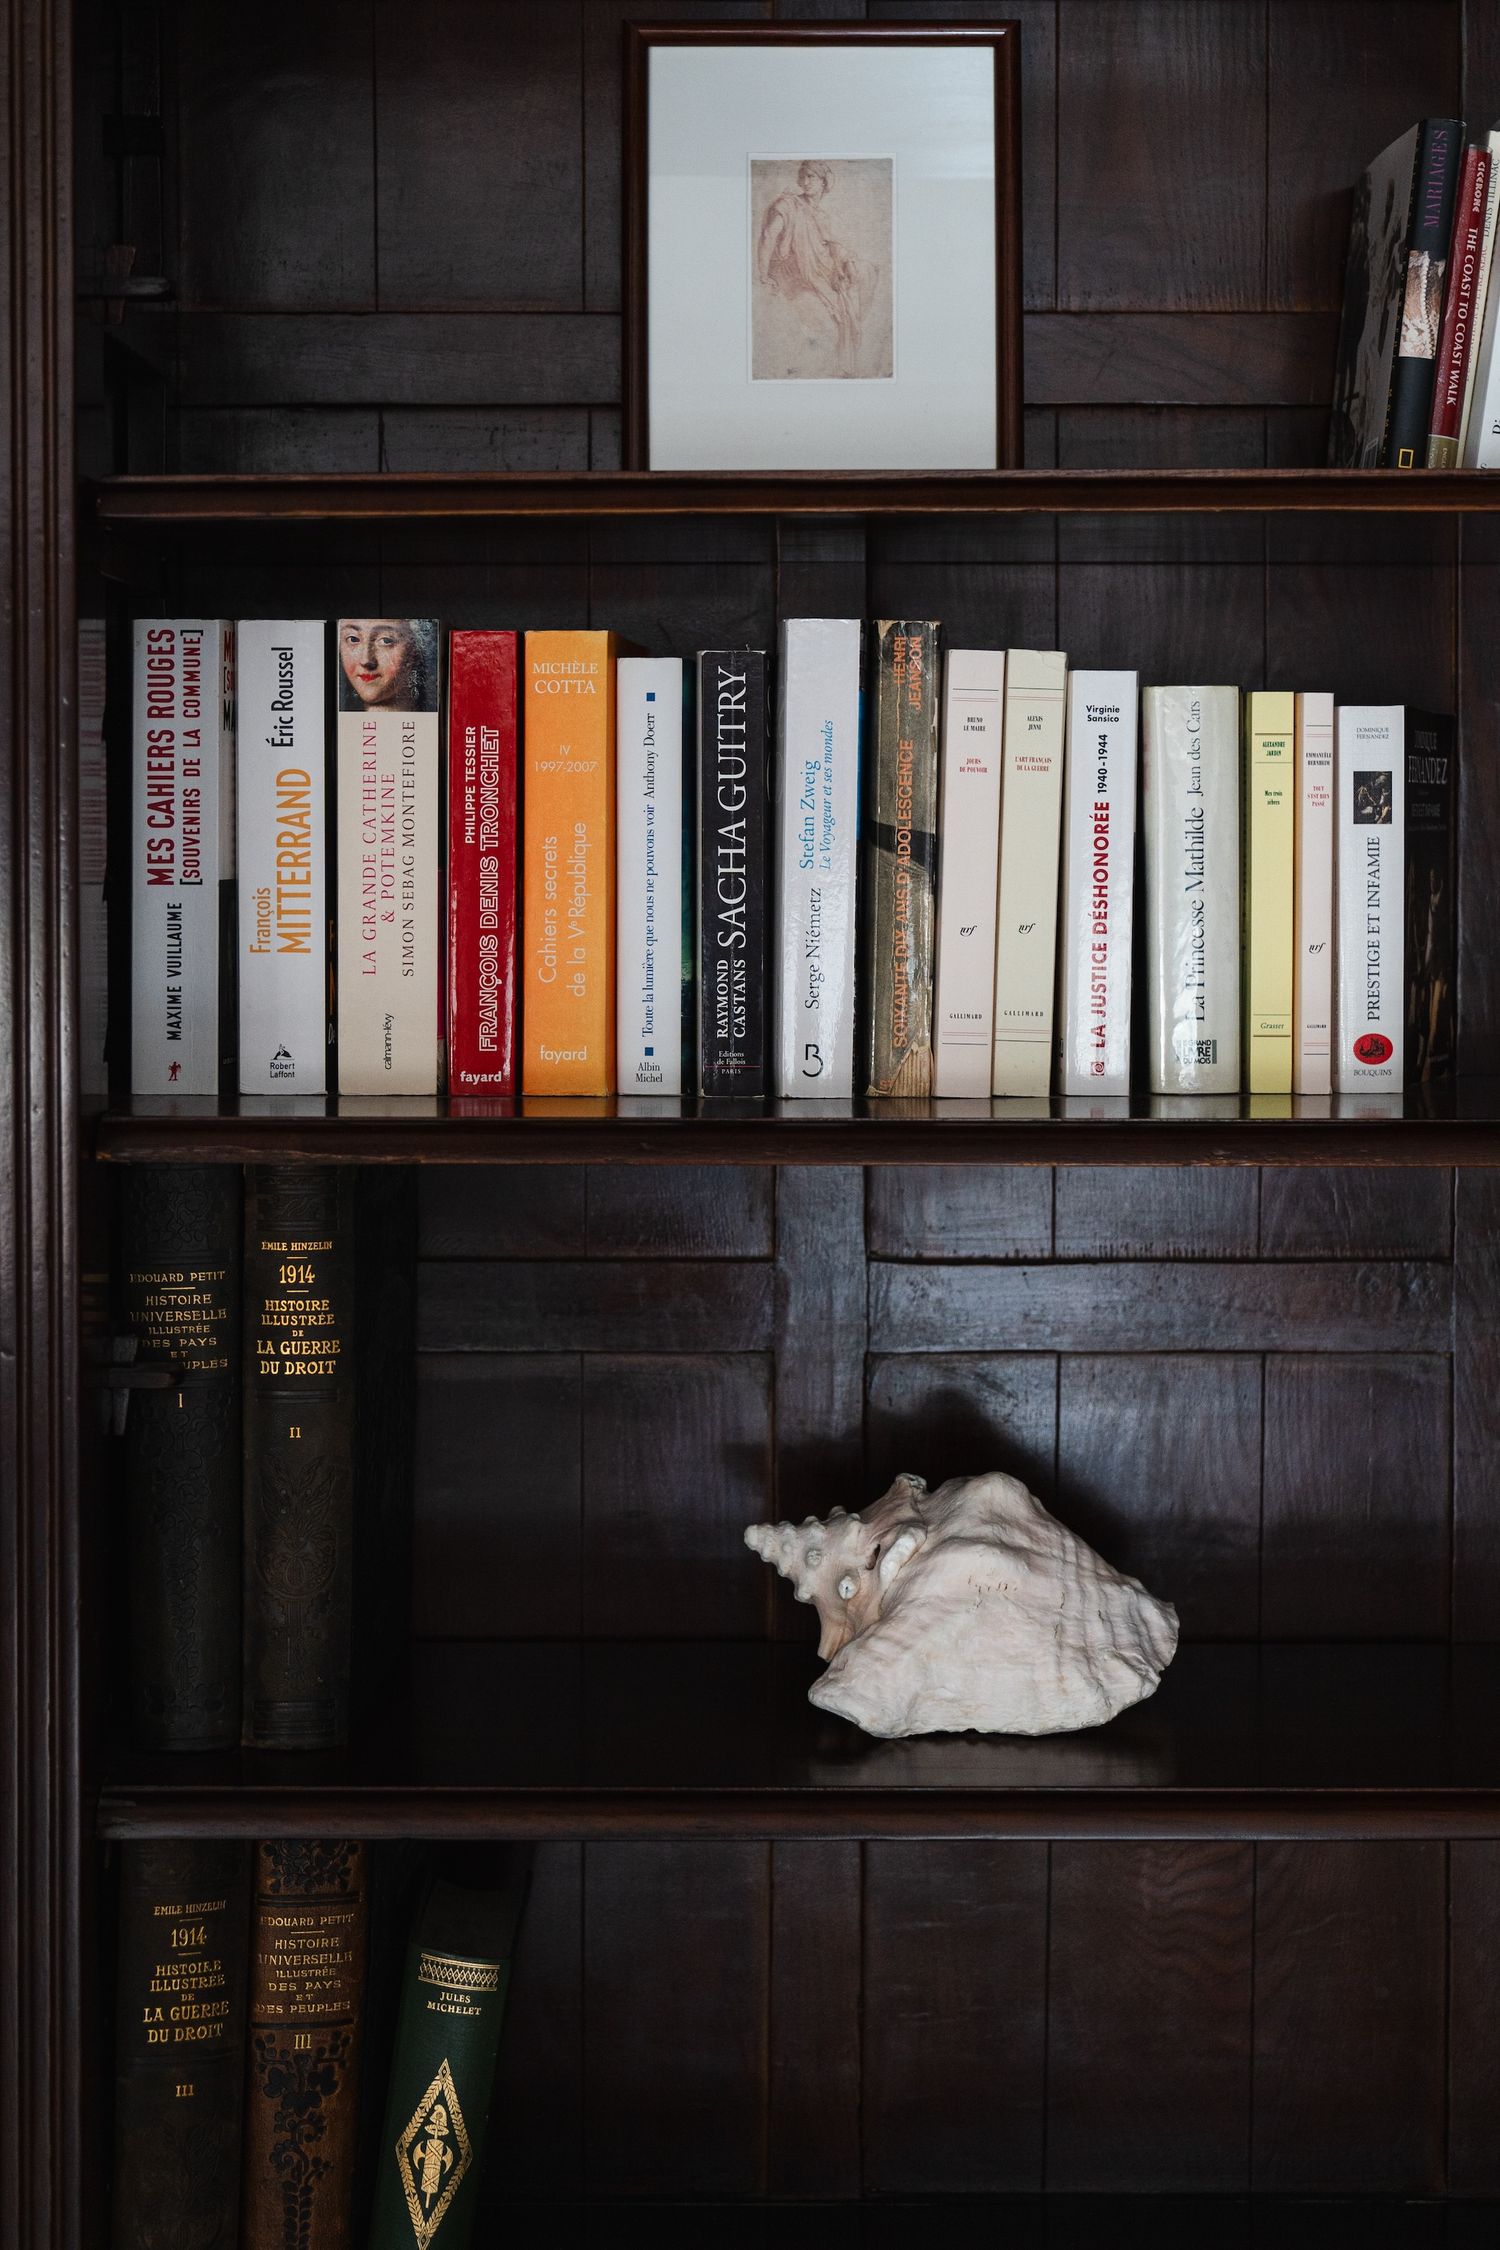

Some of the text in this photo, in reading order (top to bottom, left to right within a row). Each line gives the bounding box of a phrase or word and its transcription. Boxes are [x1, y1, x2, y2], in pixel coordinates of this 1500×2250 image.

[1424, 129, 1448, 228] MARIAGES
[1472, 161, 1486, 213] CICERONE
[1466, 227, 1479, 252] THE
[1457, 253, 1475, 297] COAST
[1457, 300, 1469, 320] TO
[1450, 323, 1467, 367] COAST
[1446, 369, 1461, 406] WALK
[532, 660, 599, 675] MICHÈLE
[893, 636, 907, 684] HENRI
[909, 636, 922, 711] JEANSON
[266, 646, 294, 748] Éric Roussel
[534, 678, 597, 696] COTTA
[1086, 705, 1121, 716] Virginie
[1087, 714, 1120, 723] Sansico
[147, 628, 176, 887] MES CAHIERS ROUGES
[180, 629, 204, 886] [SOUVENIRS DE LA COMMUNE]
[559, 744, 571, 756] IV
[643, 713, 659, 799] Anthony Doerr
[1186, 699, 1204, 797] Jean des Cars
[533, 760, 597, 773] 1997-2007
[465, 726, 477, 844] PHILIPPE TESSIER
[819, 719, 836, 870] Le Voyageur et ses mondes
[716, 666, 747, 949] SACHA GUITRY
[798, 759, 821, 870] Stefan Zweig
[362, 720, 377, 976] LA GRANDE CATHERINE
[381, 773, 396, 923] & POTEMKINE
[402, 721, 417, 977] SIMON SEBAG MONTEFIORE
[275, 768, 312, 954] MITTERRAND
[566, 821, 592, 918] République
[478, 725, 501, 1053] FRANÇOIS DENIS TRONCHET
[537, 834, 558, 985] Cahiers secrets
[896, 888, 909, 924] ANS
[1184, 806, 1206, 1022] La Princesse Mathilde
[249, 887, 275, 954] François
[642, 804, 659, 1038] Toute la lumière que nous ne pouvons voir
[1018, 922, 1037, 935] nrf
[1088, 801, 1111, 1049] LA JUSTICE DÉSHONORÉE
[1366, 836, 1381, 1022] PRESTIGE ET INFAMIE
[959, 925, 978, 937] nrf
[571, 946, 587, 967] la
[804, 887, 826, 1010] Serge Niémetz
[1309, 942, 1326, 954] nrf
[167, 902, 182, 1041] MAXIME VUILLAUME
[571, 971, 587, 997] de
[716, 959, 729, 1038] RAYMOND
[733, 958, 746, 1038] CASTANS
[893, 960, 909, 1049] SOIXANTE
[949, 1012, 983, 1020] GALLIMARD
[1003, 1009, 1044, 1017] GALLIMARD
[540, 1045, 588, 1066] fayard
[269, 1062, 295, 1070] Robert
[269, 1070, 296, 1079] Laffont
[637, 1062, 661, 1072] Albin
[1353, 1069, 1393, 1077] BOUQUINS
[460, 1071, 502, 1085] fayard
[635, 1073, 663, 1083] Michel
[290, 1241, 333, 1251] HINZELIN
[190, 1270, 226, 1282] PETIT
[279, 1264, 316, 1284] 1914
[146, 1293, 213, 1306] HISTOIRE
[264, 1299, 330, 1312] HISTOIRE
[130, 1308, 227, 1323] UNIVERSELLE
[261, 1311, 335, 1326] ILLUSTRÉE
[148, 1323, 211, 1335] ILLUSTRÉE
[291, 1329, 305, 1337] DE
[141, 1336, 217, 1348] DES PAYS
[256, 1339, 341, 1355] LA GUERRE
[259, 1360, 337, 1376] DU DROIT
[289, 1427, 302, 1439] II
[319, 1913, 354, 1925] PETIT
[170, 1926, 208, 1948] 1914
[274, 1936, 340, 1950] HISTOIRE
[156, 1960, 222, 1977] HISTOIRE
[257, 1951, 353, 1966] UNIVERSELLE
[275, 1965, 337, 1978] ILLUSTRÉE
[149, 1974, 226, 1992] ILLUSTRÉE
[268, 1979, 341, 1991] DES PAYS
[181, 1993, 195, 2001] DE
[439, 1991, 472, 2004] JULES
[143, 2001, 230, 2023] LA GUERRE
[256, 2001, 351, 2014] DES PEUPLES
[426, 2002, 482, 2017] MICHELET
[147, 2022, 225, 2044] DU DROIT
[294, 2034, 312, 2050] III
[175, 2084, 195, 2097] III
